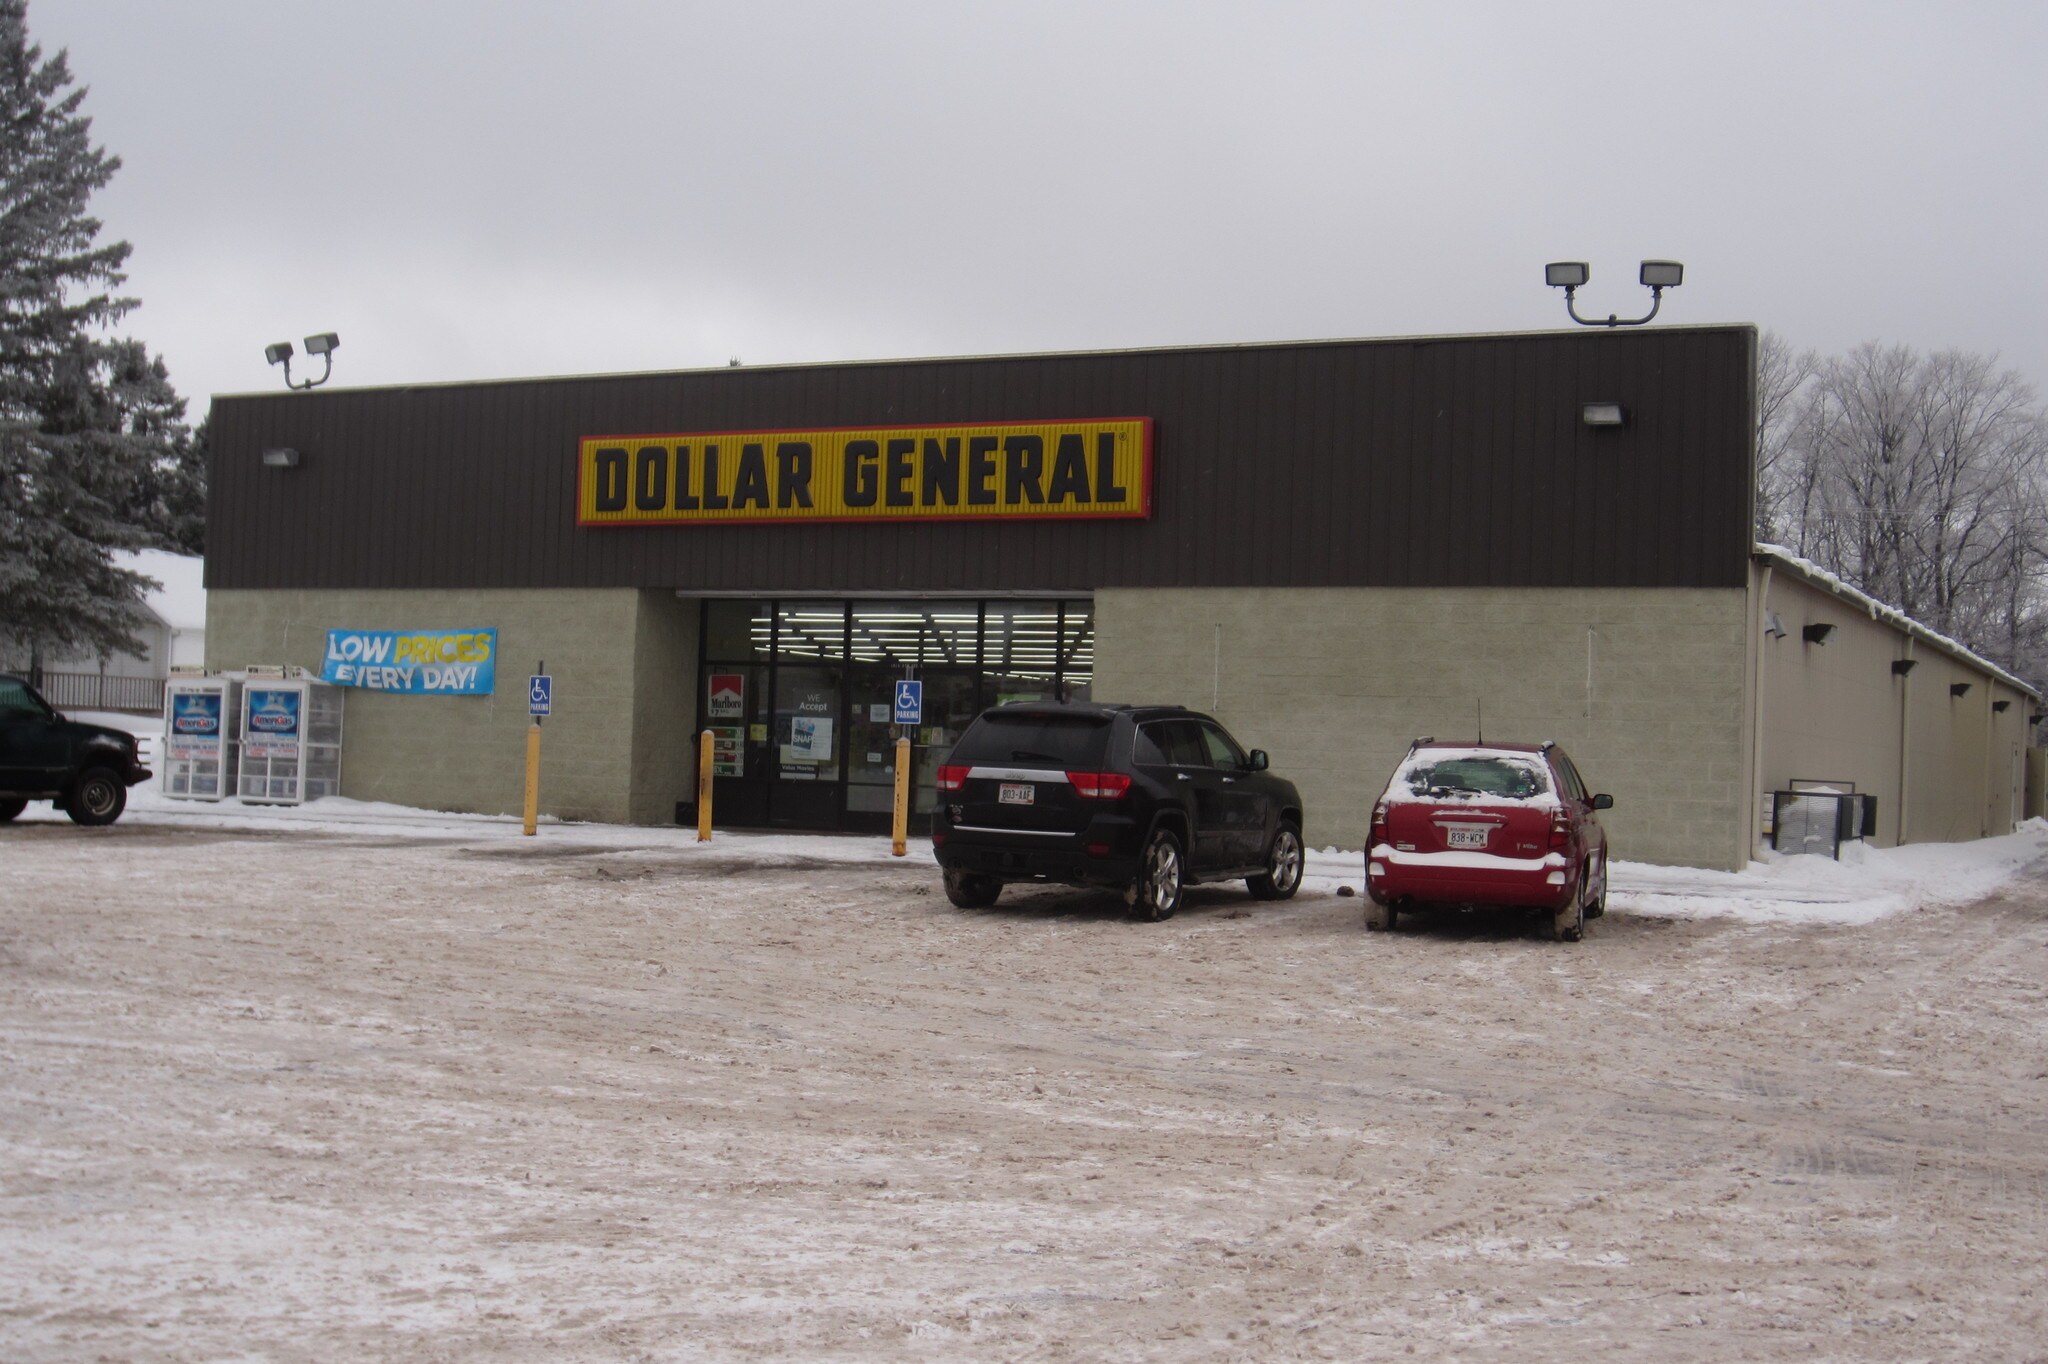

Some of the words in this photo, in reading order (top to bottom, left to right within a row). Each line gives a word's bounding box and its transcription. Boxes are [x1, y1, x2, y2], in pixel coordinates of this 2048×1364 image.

[595, 441, 814, 512] DOLLAR
[843, 431, 1127, 507] GENERAL
[328, 633, 392, 664] LOW
[393, 633, 492, 664] PRICES
[335, 664, 415, 690] EVERY
[423, 665, 478, 690] DAY!
[711, 695, 742, 709] Marlboro
[807, 694, 821, 702] WE
[799, 702, 828, 712] Accept
[896, 710, 919, 719] PARKING
[793, 735, 813, 744] SNAP
[1451, 832, 1484, 844] 838-WCM
